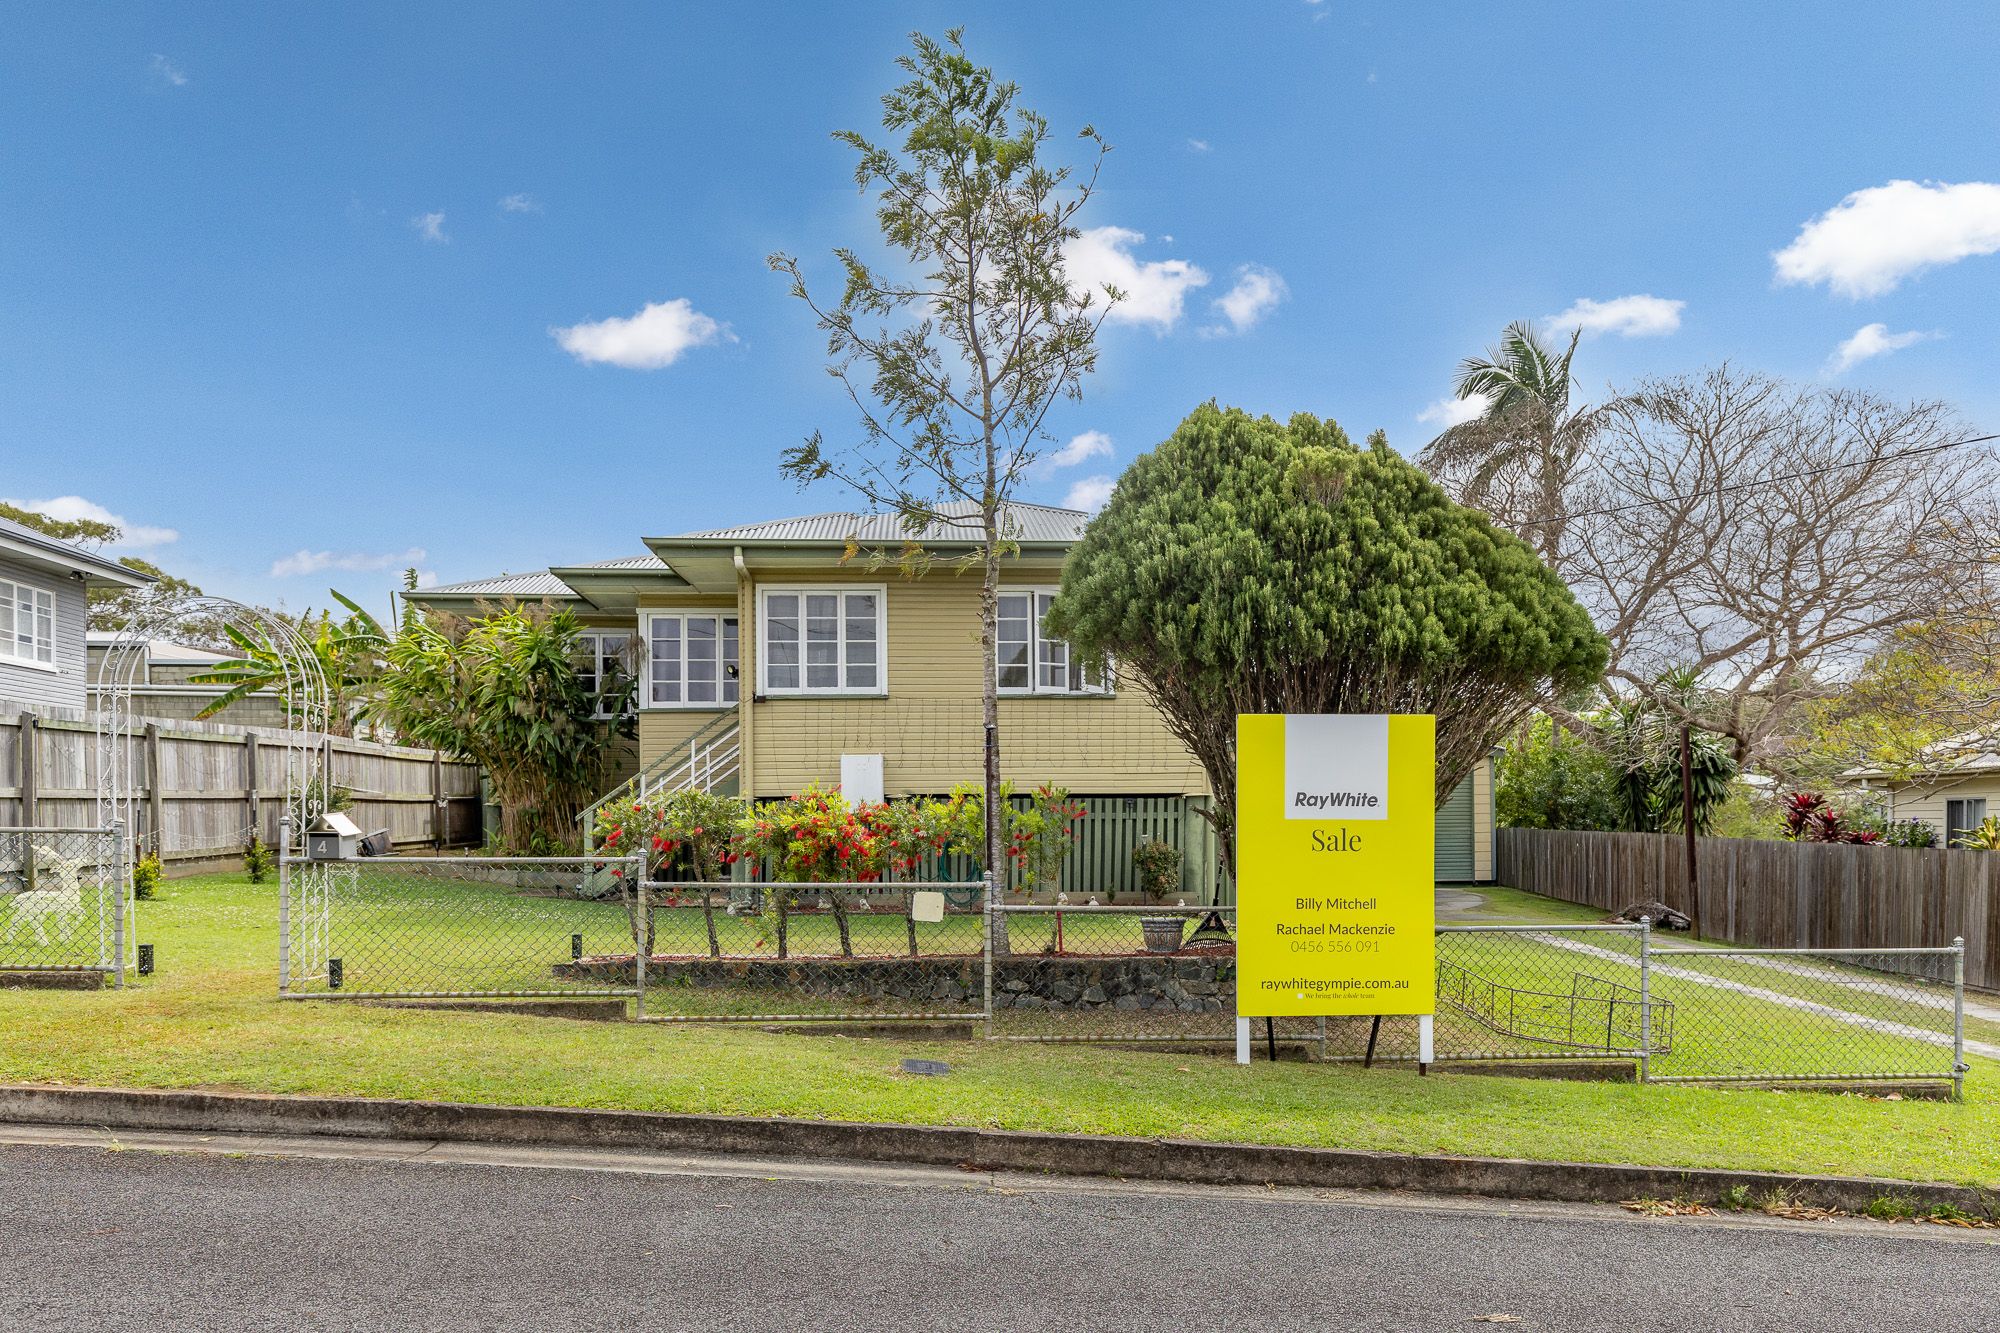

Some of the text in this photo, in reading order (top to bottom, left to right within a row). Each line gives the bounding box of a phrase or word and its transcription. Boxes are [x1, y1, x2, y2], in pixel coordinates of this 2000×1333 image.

[1295, 792, 1378, 809] RayWhite
[317, 840, 327, 854] 4
[1312, 828, 1361, 852] Sale
[1296, 898, 1377, 912] Billy Mitchell
[1276, 923, 1395, 935] Rachael Mackenzie
[1290, 940, 1380, 952] 0456 556 091
[1261, 978, 1409, 991] raywhitegympie.com.au
